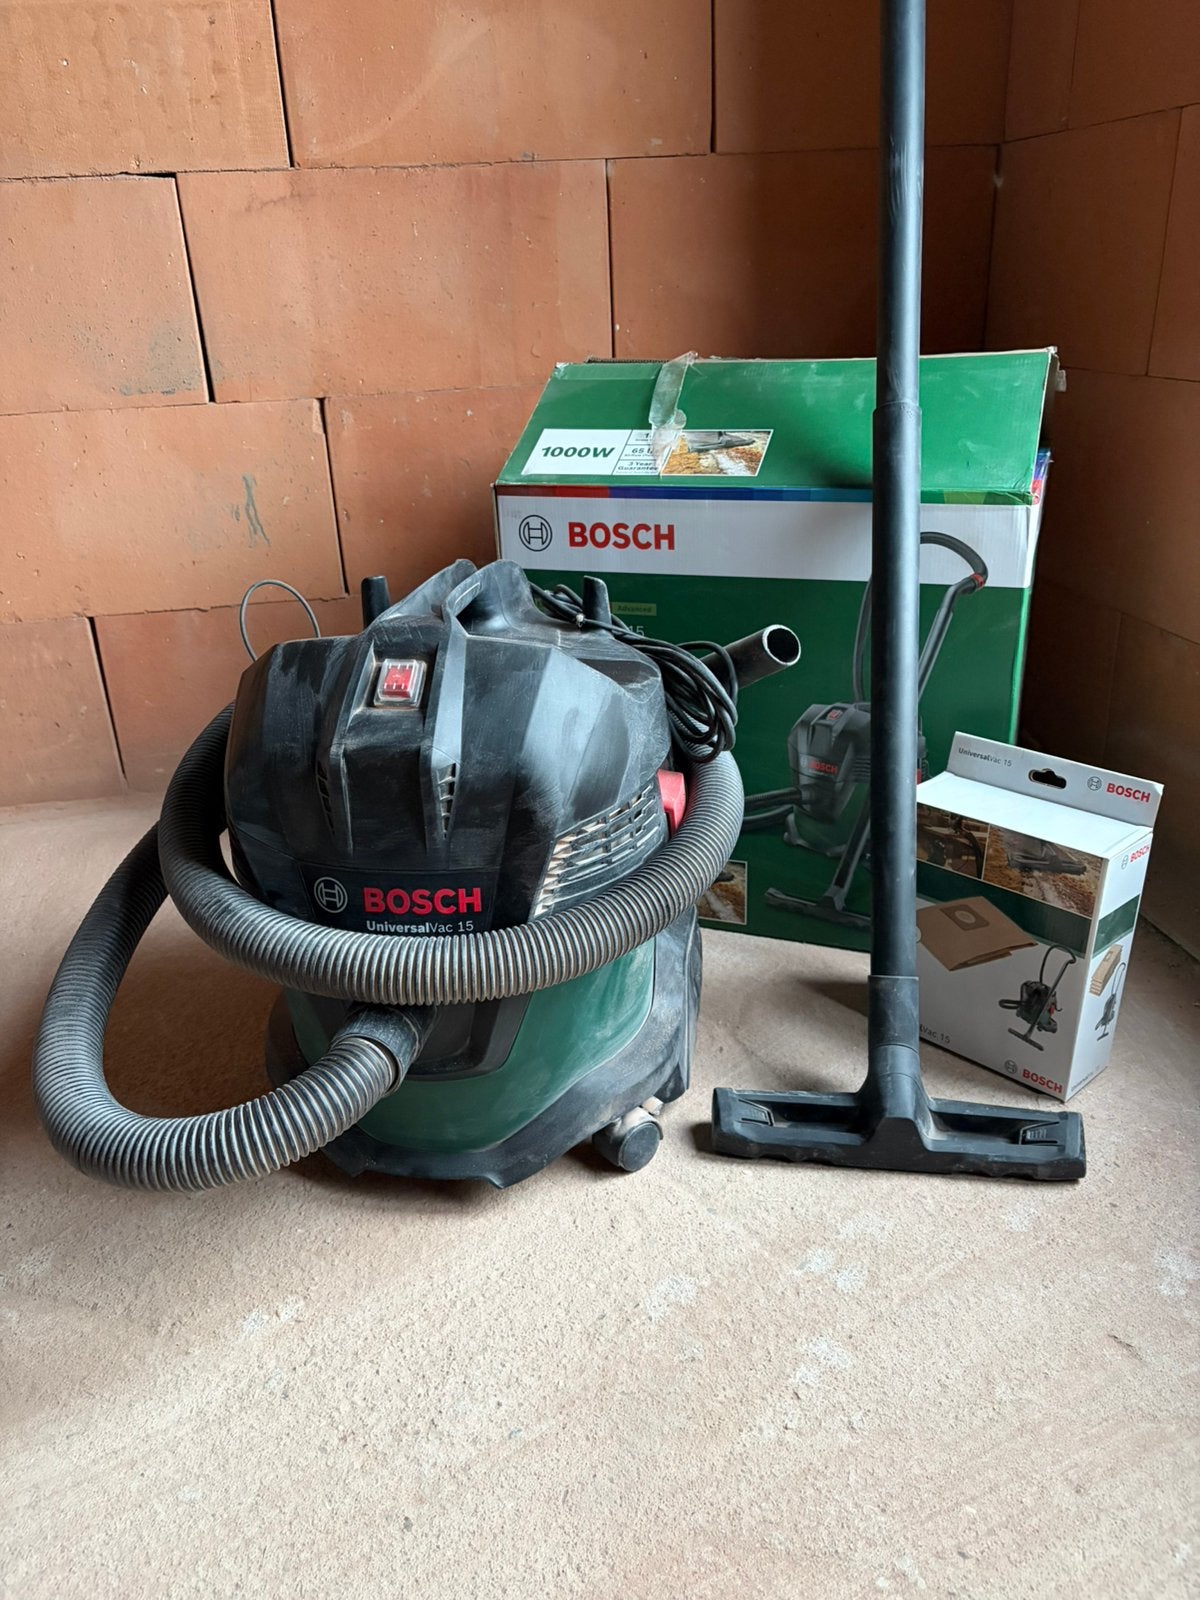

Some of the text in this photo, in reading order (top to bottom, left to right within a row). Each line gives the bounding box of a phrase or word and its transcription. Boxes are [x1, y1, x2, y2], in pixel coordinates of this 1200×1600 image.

[541, 446, 615, 458] 1000W
[568, 522, 675, 550] BOSCH
[1003, 759, 1013, 767] 15
[1106, 782, 1151, 803] BOSCH
[1130, 844, 1150, 863] BOSCH
[363, 887, 482, 915] BOSCH
[366, 920, 474, 933] UniversalVac 15
[1022, 1069, 1062, 1093] BOSCH
